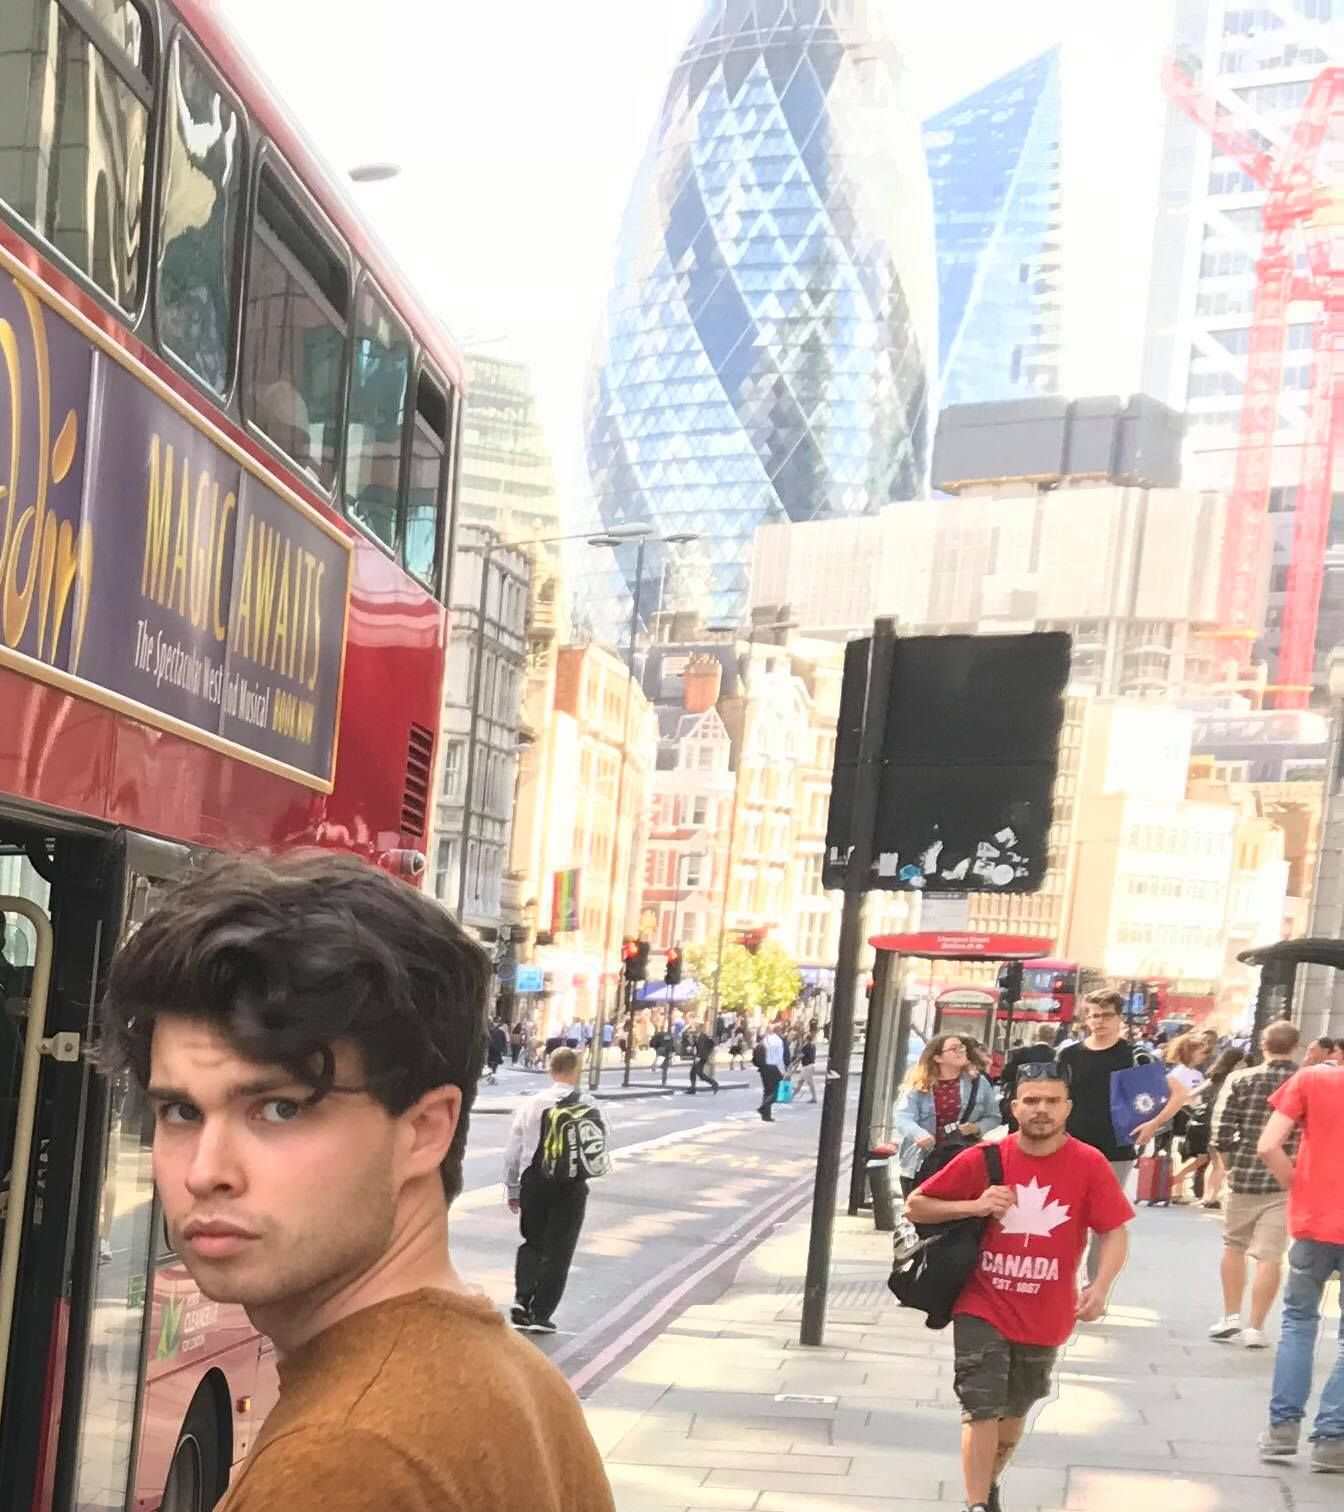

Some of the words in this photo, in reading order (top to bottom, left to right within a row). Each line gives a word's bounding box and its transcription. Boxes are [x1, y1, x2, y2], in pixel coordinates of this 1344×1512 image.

[141, 433, 236, 641] MAGIC
[234, 513, 325, 691] AWAITS
[135, 619, 155, 672] The
[154, 630, 202, 695] Spectacular
[203, 656, 224, 705] West
[238, 678, 270, 730] Musical
[981, 1250, 1059, 1281] CANADA
[992, 1277, 1013, 1292] EST.
